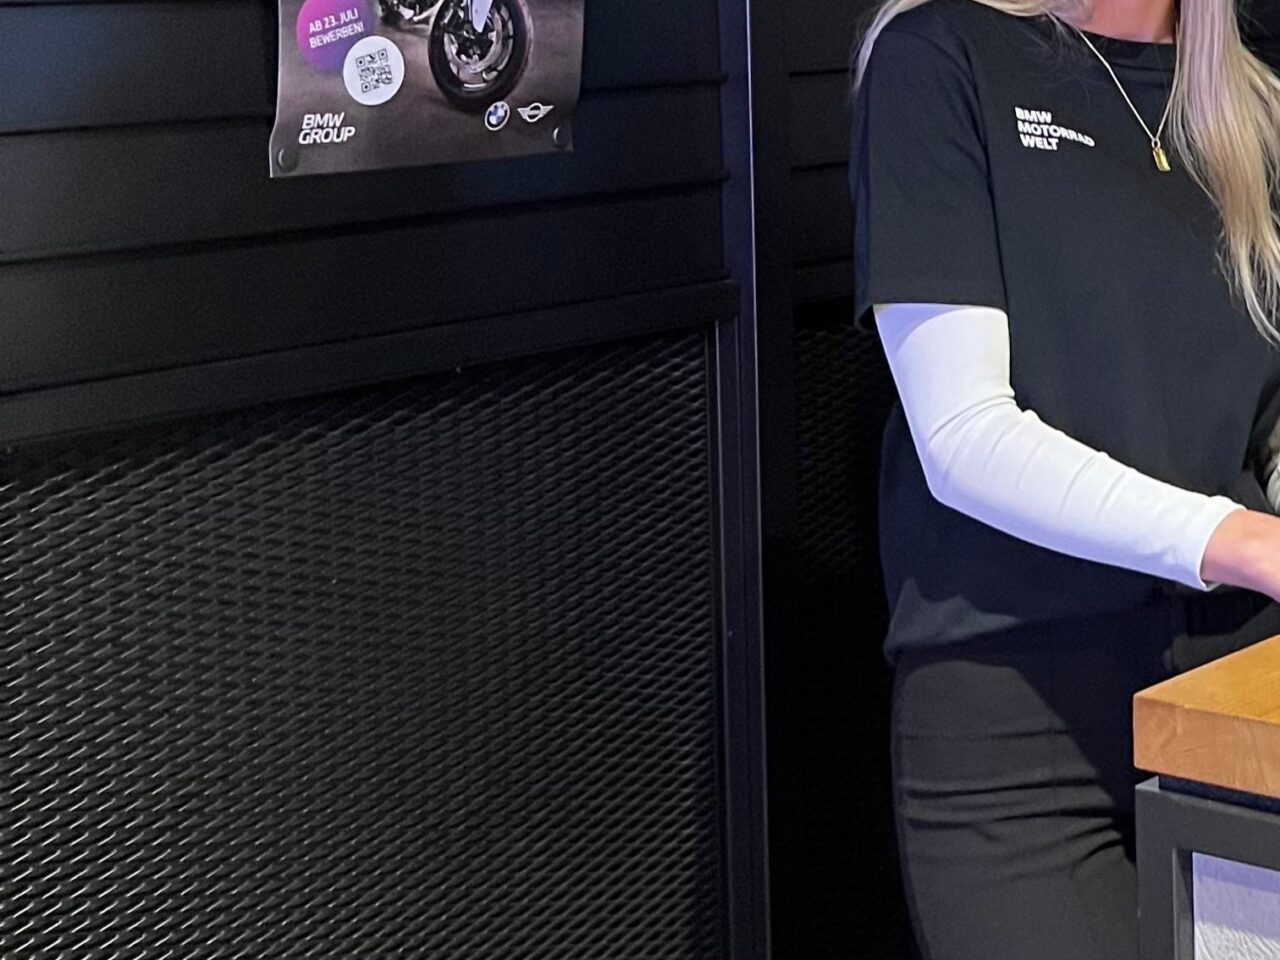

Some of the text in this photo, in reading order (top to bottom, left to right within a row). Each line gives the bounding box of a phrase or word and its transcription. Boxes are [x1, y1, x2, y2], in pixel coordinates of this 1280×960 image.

[309, 8, 359, 34] AB 23. JULI
[309, 21, 365, 48] BEWERBEN!
[302, 112, 345, 130] BMW
[1015, 106, 1051, 123] BMW
[298, 126, 356, 144] GROUP
[1017, 120, 1096, 147] MOTORRAD
[1020, 134, 1058, 151] WELT
